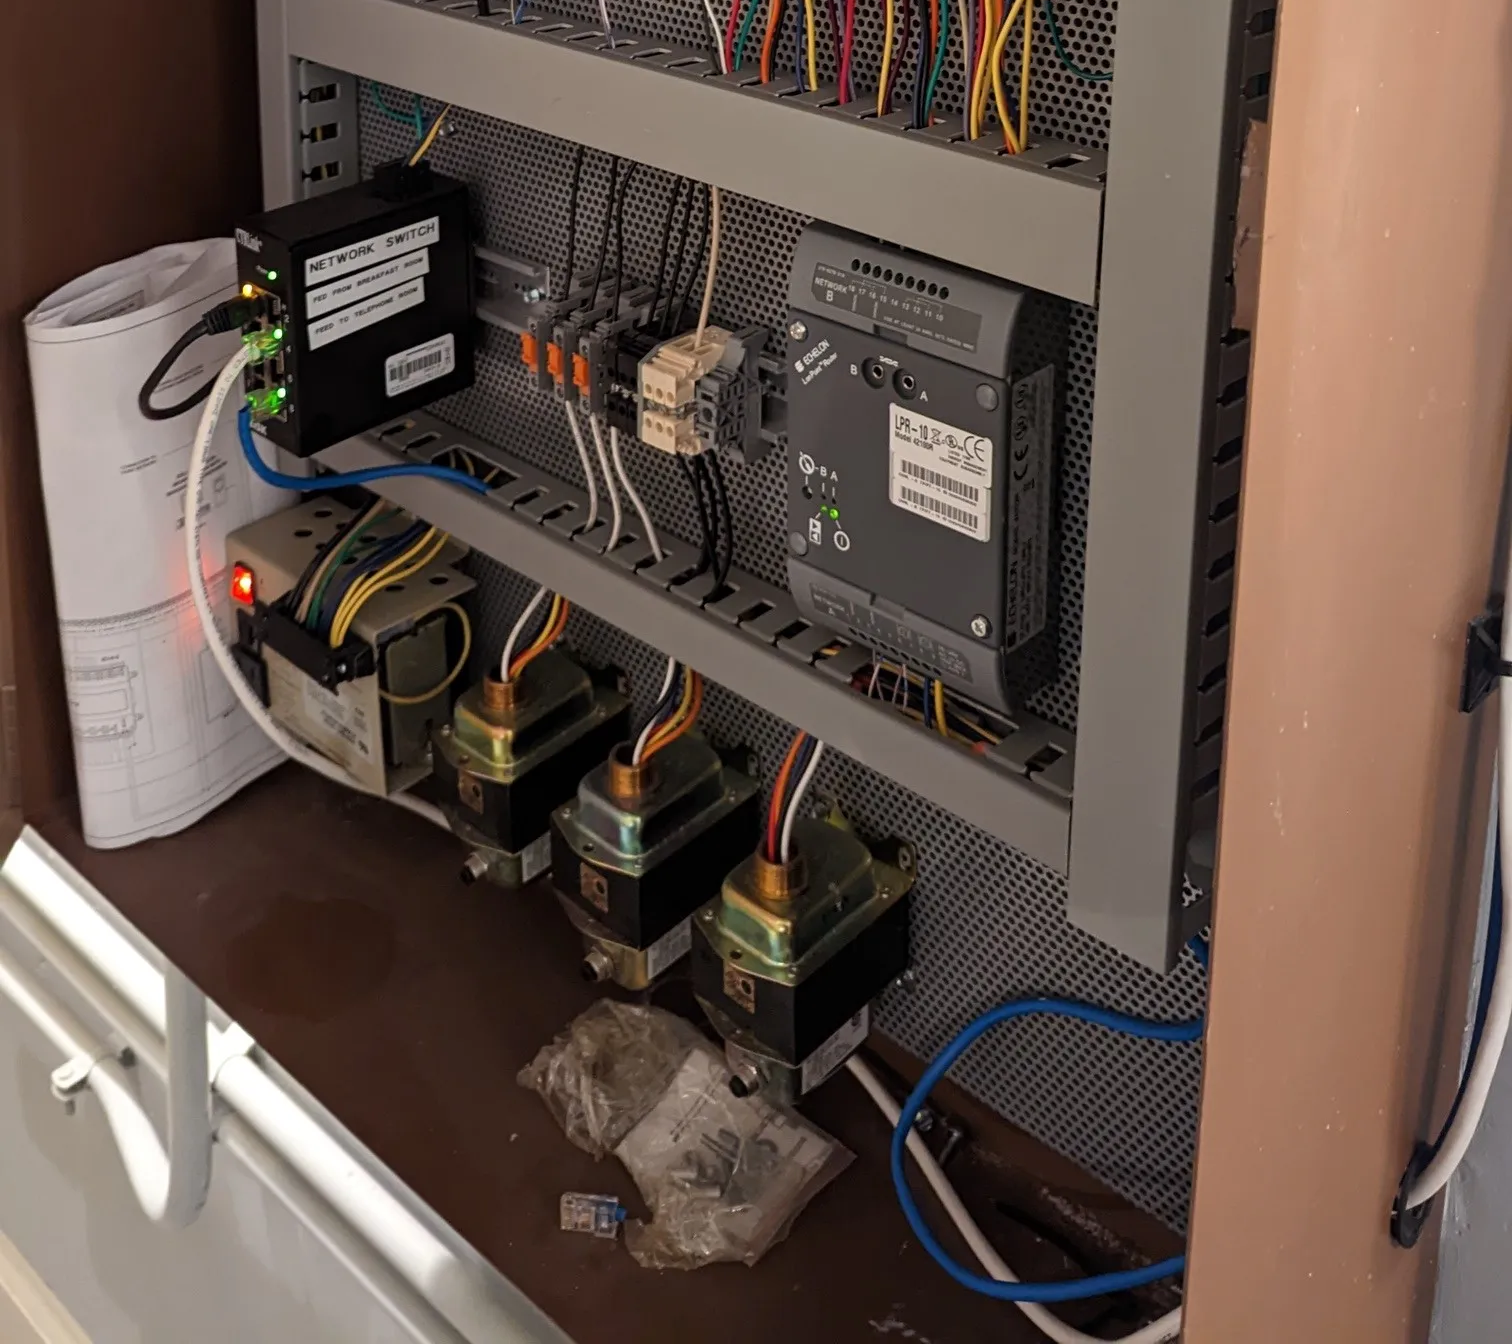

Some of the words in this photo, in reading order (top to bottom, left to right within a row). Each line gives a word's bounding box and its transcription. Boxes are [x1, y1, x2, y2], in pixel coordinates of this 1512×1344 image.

[309, 243, 375, 273] NETWORK
[386, 222, 436, 248] SWITCH
[313, 294, 327, 304] FED
[332, 284, 352, 296] FROM
[357, 266, 399, 286] BREAKFAST
[404, 257, 424, 269] ROOM
[814, 277, 847, 294] NETWORK
[913, 306, 921, 314] 12
[925, 310, 932, 318] 11
[826, 291, 834, 302] B
[315, 323, 334, 334] FEED
[340, 316, 349, 324] TO
[354, 297, 394, 318] TELEPHONE
[398, 287, 418, 298] ROOM
[802, 339, 830, 365] ECHELON
[850, 364, 858, 375] B
[920, 391, 928, 402] A
[895, 430, 911, 442] Model
[820, 466, 827, 476] B
[830, 471, 838, 482] A
